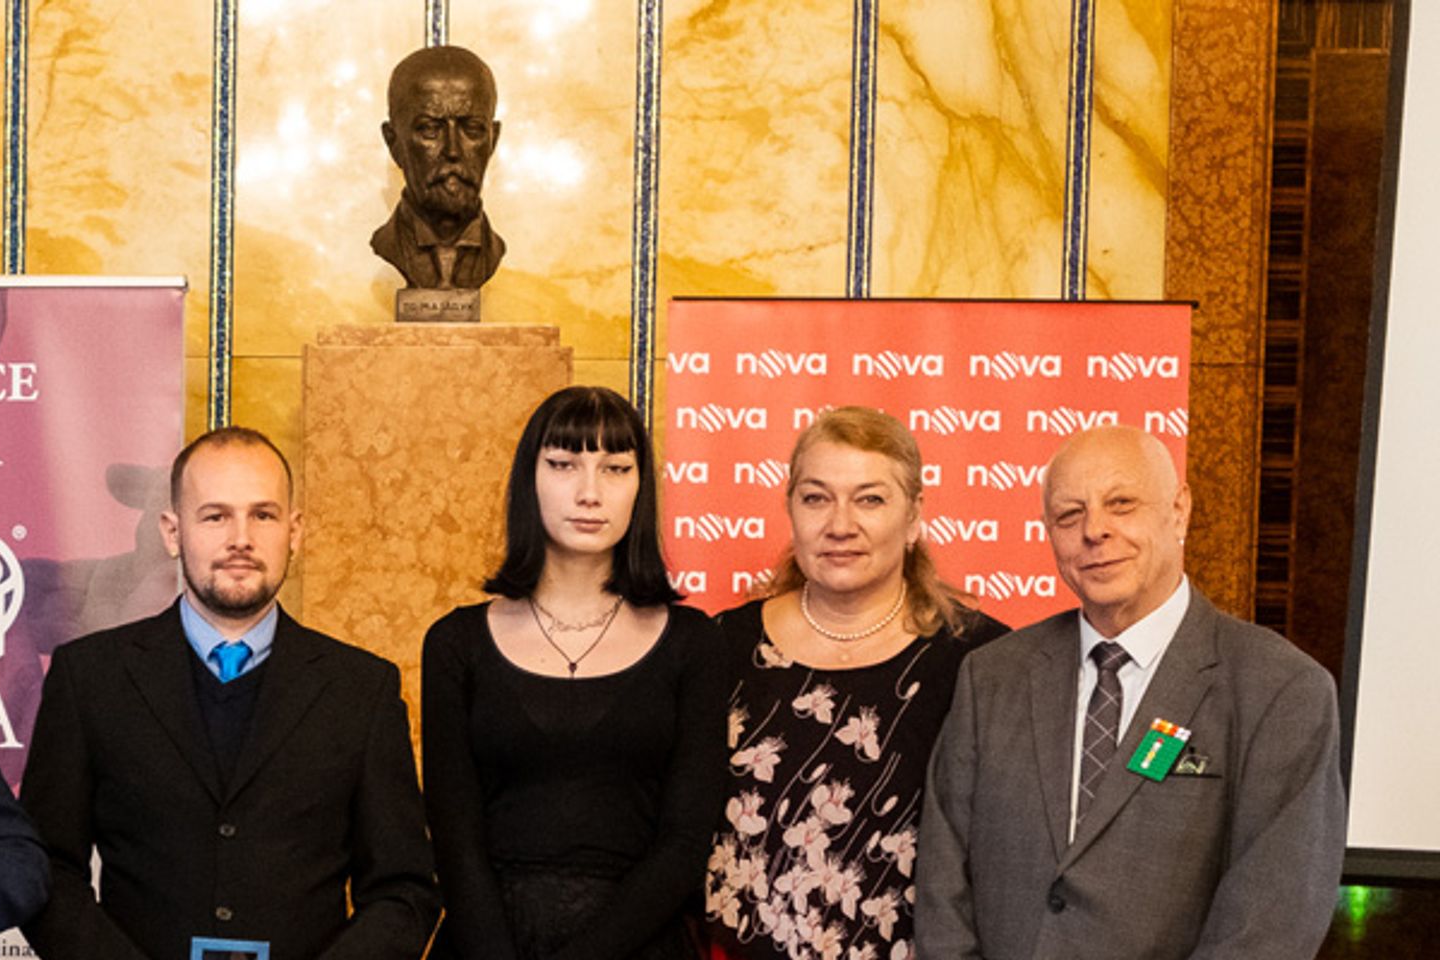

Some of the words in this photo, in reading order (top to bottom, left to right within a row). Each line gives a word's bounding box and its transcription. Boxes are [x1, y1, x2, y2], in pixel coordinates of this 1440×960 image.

[666, 352, 710, 375] va
[736, 349, 827, 379] nova
[852, 350, 944, 380] nova
[969, 351, 1062, 381] nova
[1087, 352, 1179, 381] nova
[676, 403, 767, 433] nova
[910, 406, 1001, 435] nova
[1145, 408, 1189, 437] no
[664, 461, 708, 484] va
[674, 513, 765, 542] nova
[667, 571, 707, 592] va
[964, 571, 1056, 600] nova
